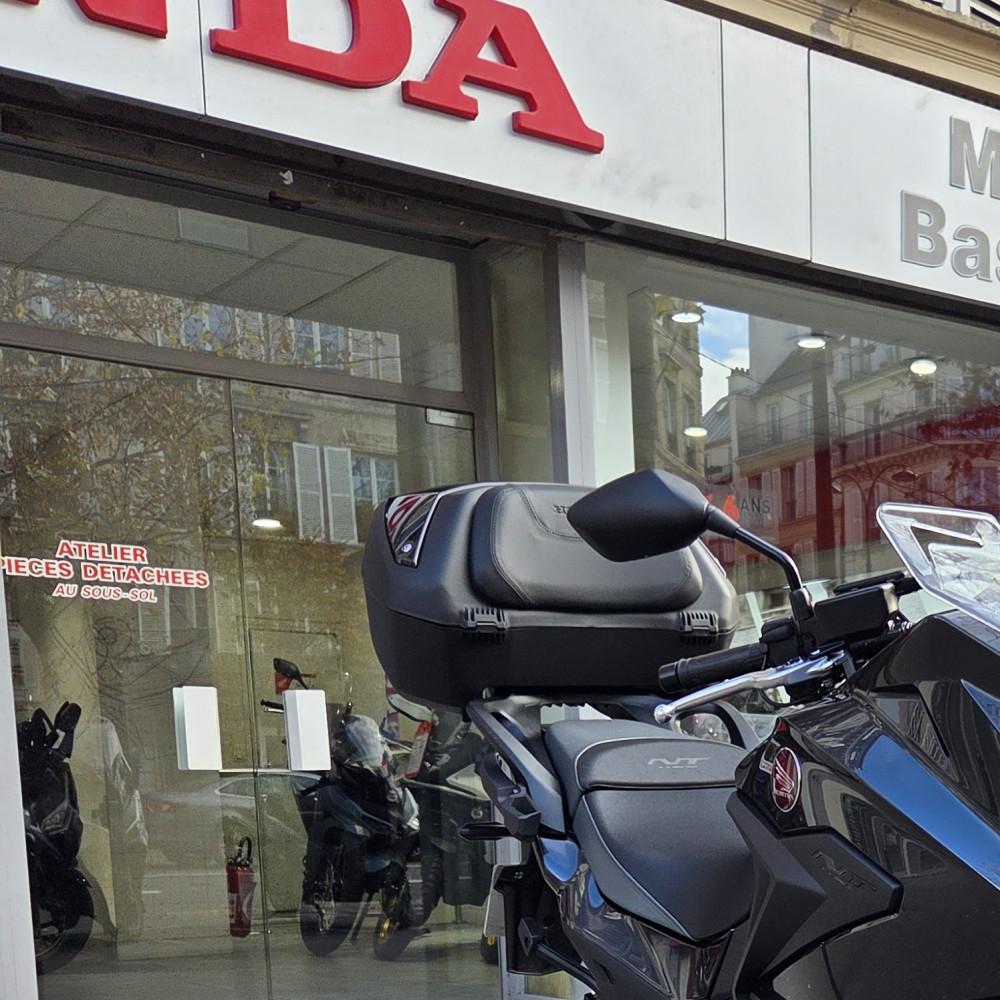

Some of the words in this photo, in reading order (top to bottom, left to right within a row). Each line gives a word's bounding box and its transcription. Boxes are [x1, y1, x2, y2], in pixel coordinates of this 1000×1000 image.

[741, 498, 771, 514] ANS
[56, 540, 148, 564] ATELIER
[82, 563, 210, 588] DETACHEES
[53, 583, 77, 598] AU
[80, 584, 158, 602] SOUS-SOL
